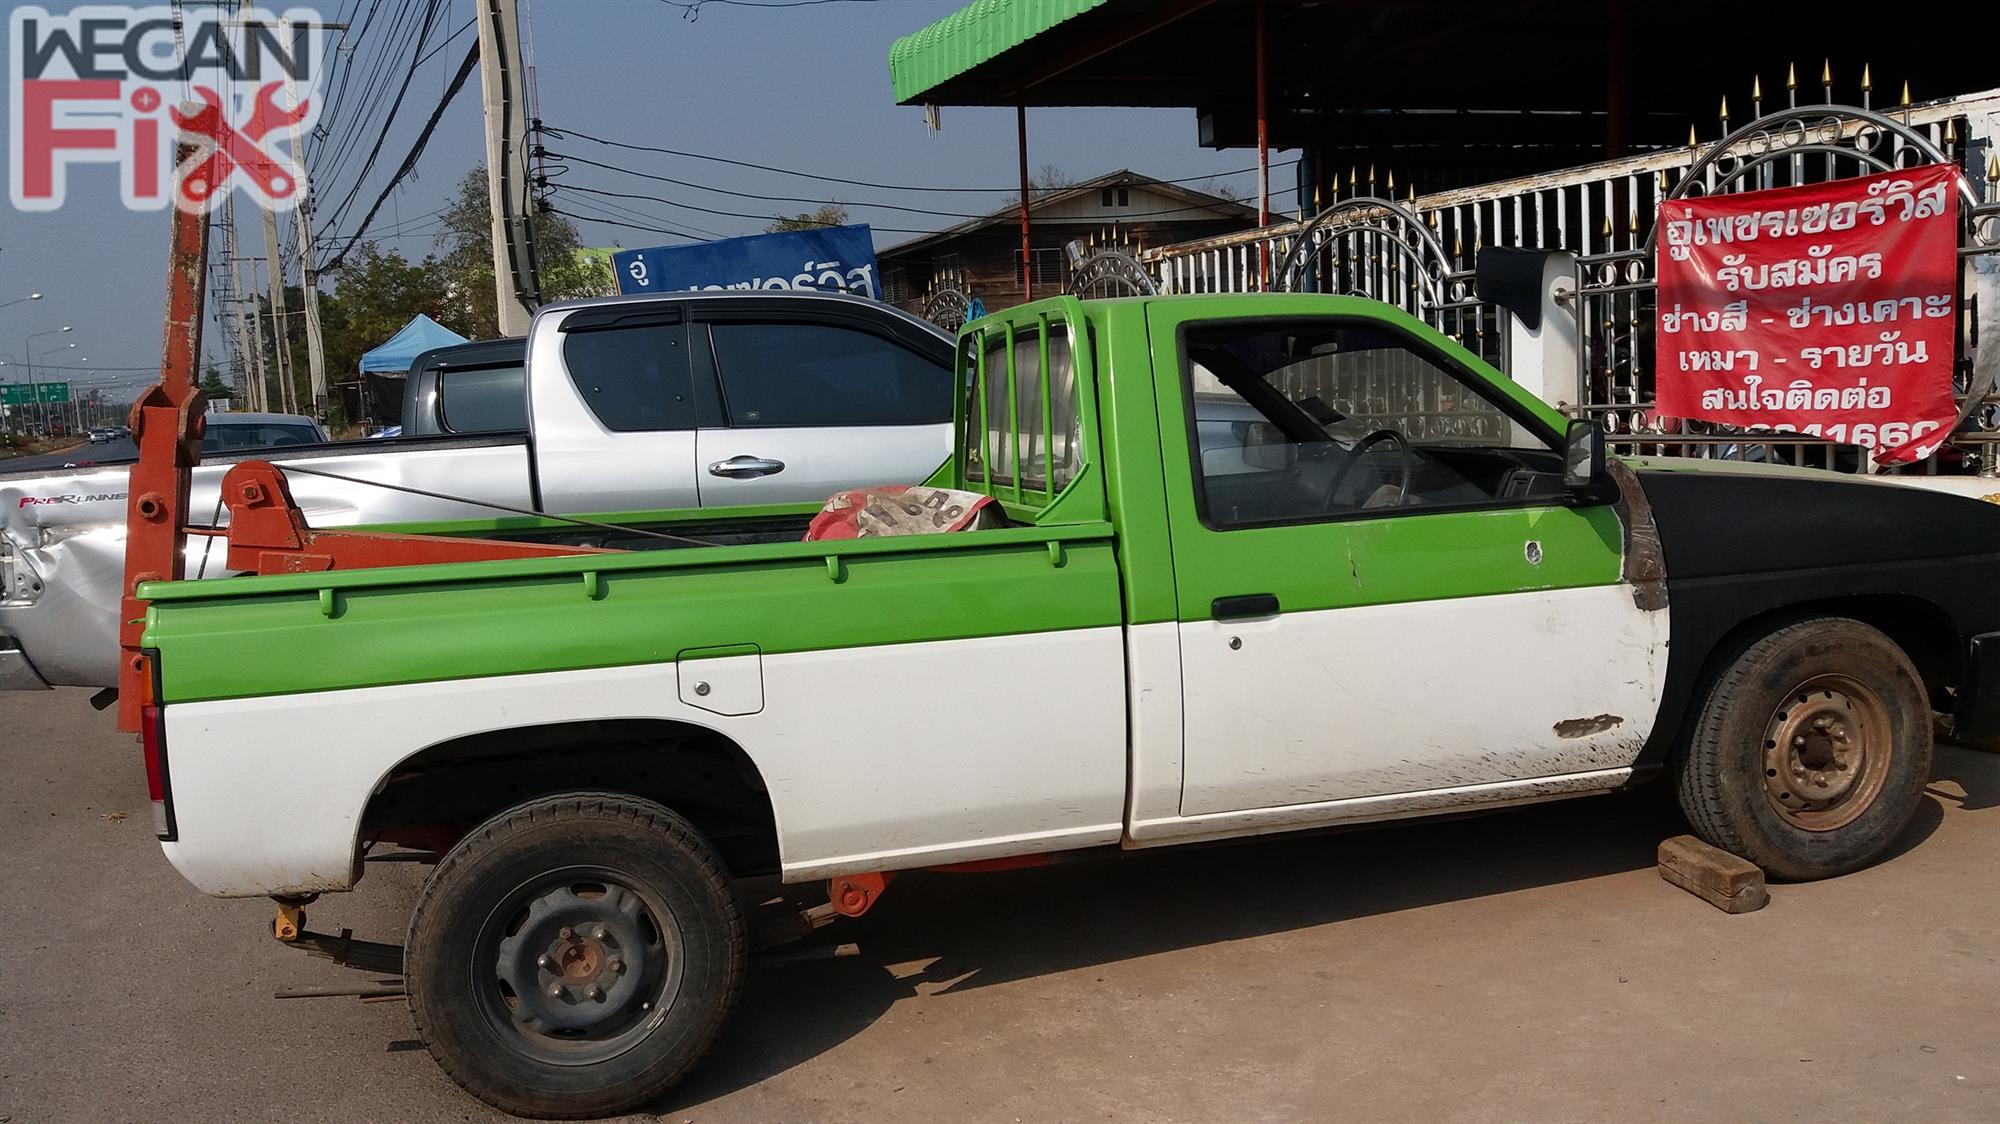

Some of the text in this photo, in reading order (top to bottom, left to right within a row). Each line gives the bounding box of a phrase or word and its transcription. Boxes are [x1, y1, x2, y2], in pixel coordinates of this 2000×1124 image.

[1716, 244, 1882, 291] รับสมัคร
[1662, 301, 1748, 333] ช่างสี
[1786, 295, 1951, 328] ช่างเคาะ
[1679, 349, 1759, 371] เหมา
[1801, 331, 1929, 369] รายวัน
[1702, 375, 1891, 410] สนใจติดต่อ
